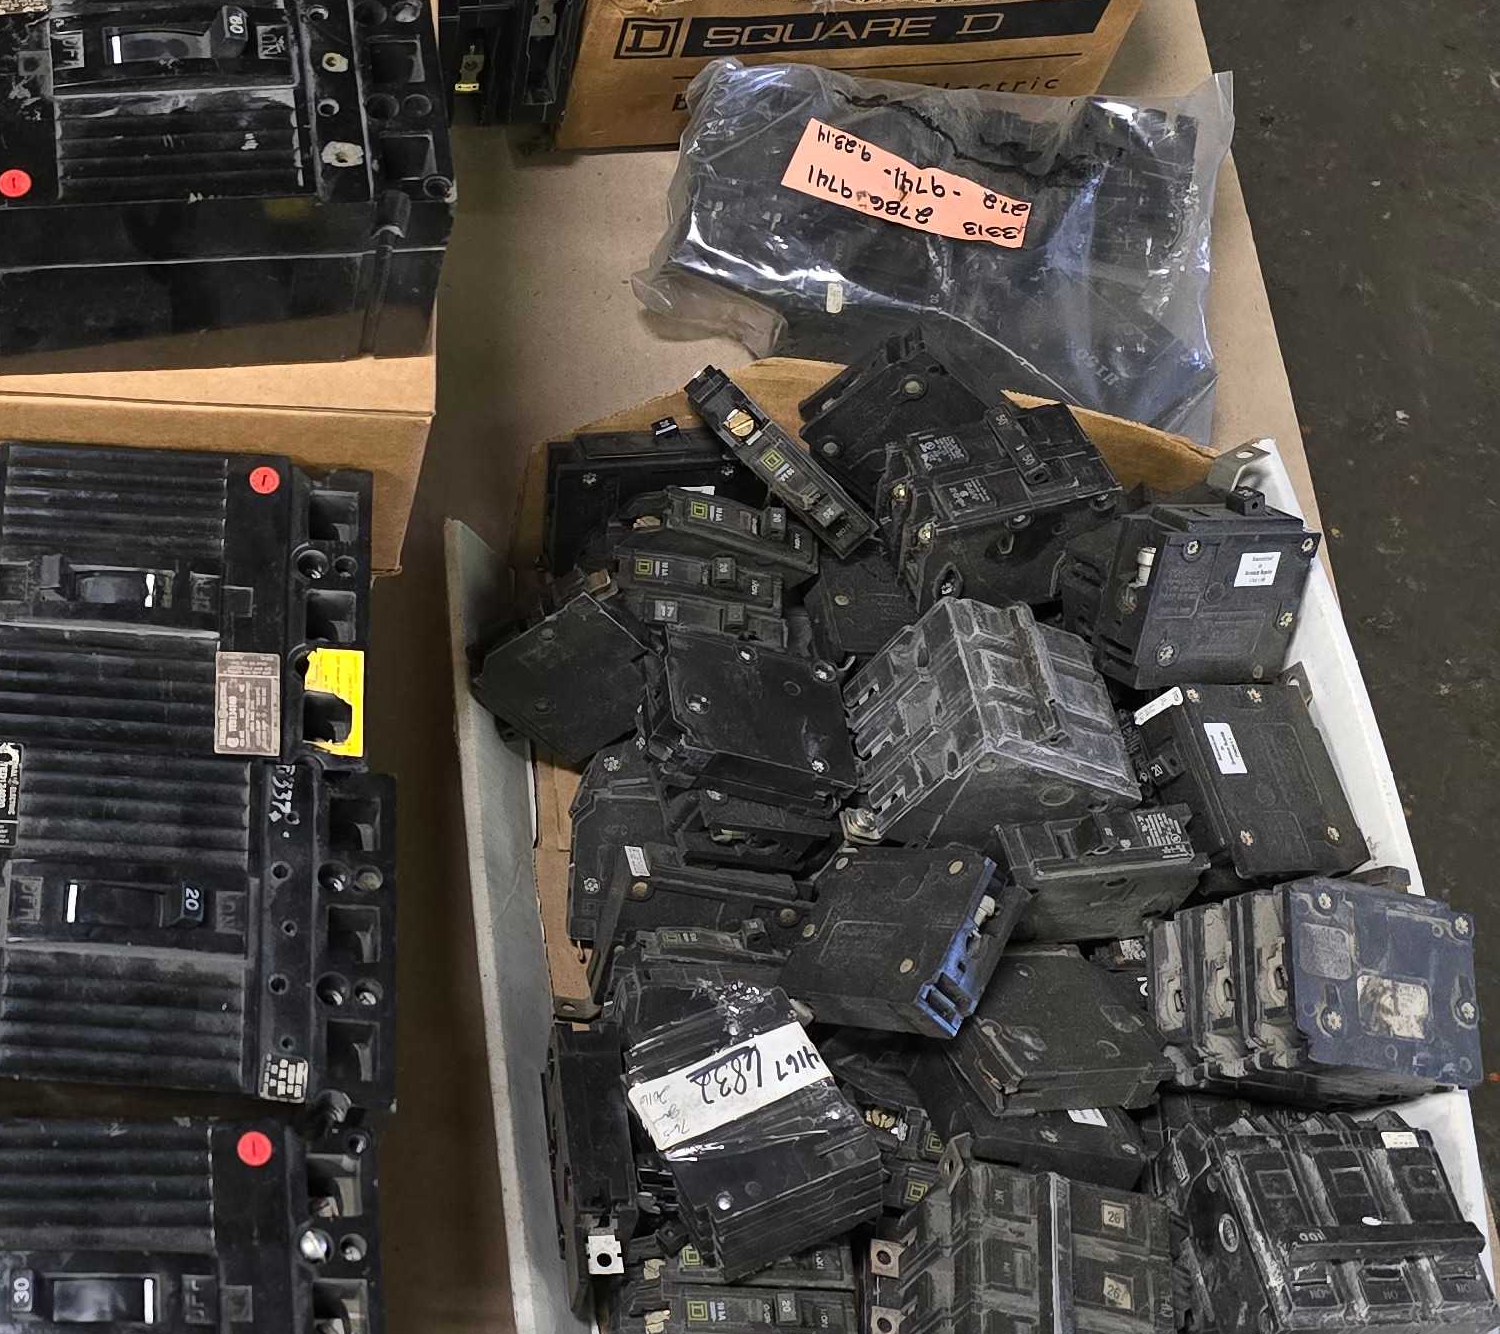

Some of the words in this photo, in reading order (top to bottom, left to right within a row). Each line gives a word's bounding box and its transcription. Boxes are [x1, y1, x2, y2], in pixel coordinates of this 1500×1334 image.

[703, 15, 933, 49] SQUARE
[954, 12, 1004, 36] D
[1021, 451, 1035, 466] 50
[1151, 763, 1164, 777] 20
[184, 886, 200, 911] 20
[13, 1276, 29, 1304] 30
[780, 1299, 792, 1313] 20
